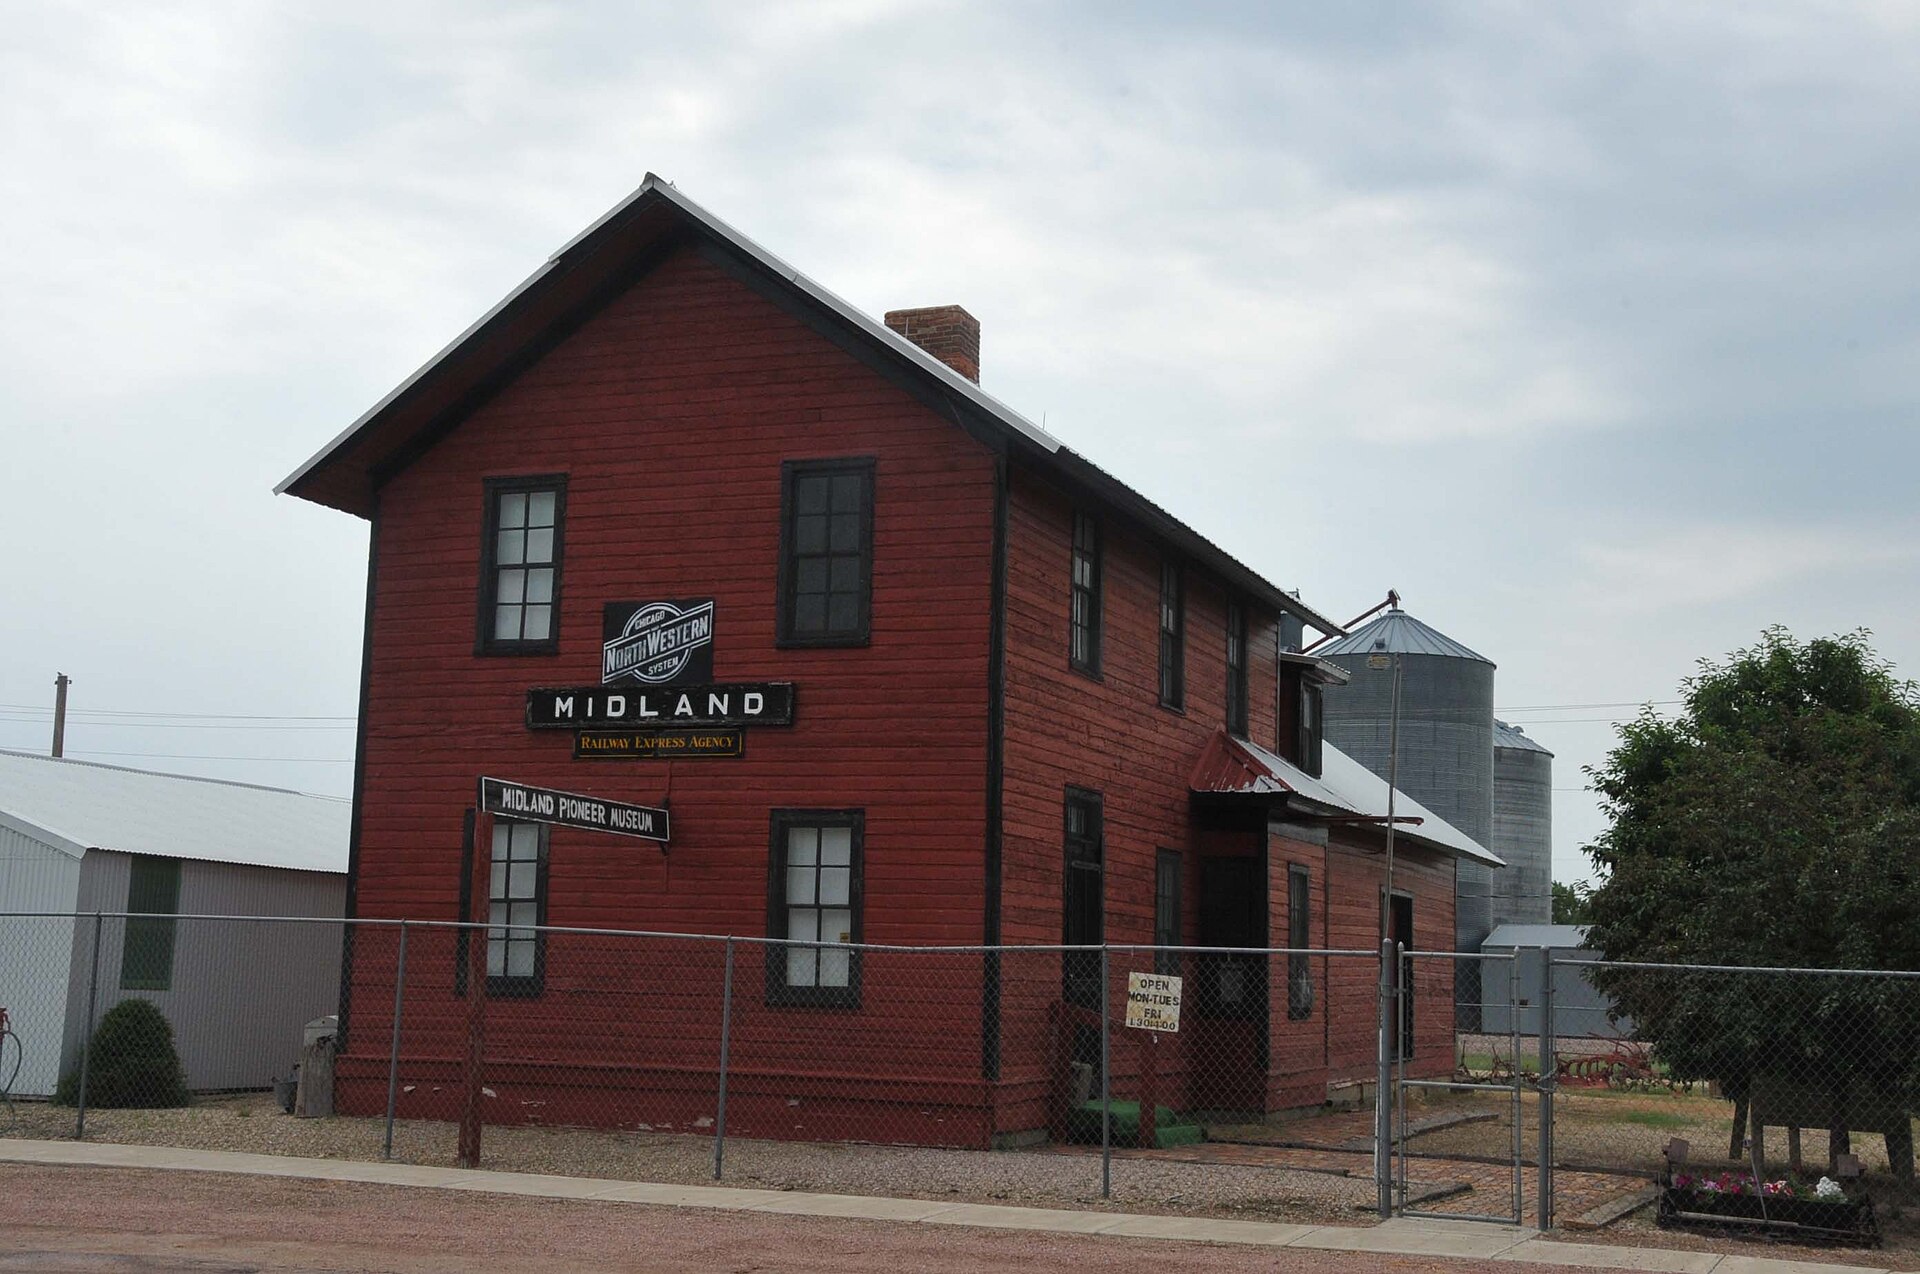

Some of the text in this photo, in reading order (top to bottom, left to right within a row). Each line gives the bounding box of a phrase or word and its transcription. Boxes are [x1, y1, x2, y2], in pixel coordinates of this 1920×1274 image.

[634, 611, 665, 630] CHICAGO
[648, 656, 679, 675] SYSTEM
[554, 692, 764, 718] MIDLAND
[581, 735, 734, 749] RAILWAY EXPRESS AGENCY
[502, 787, 653, 832] MIDLAND PIONEER MUSEUM
[1140, 979, 1170, 991] OPEN
[1127, 991, 1179, 1006] MON-TUES
[1144, 1008, 1161, 1019] FRI
